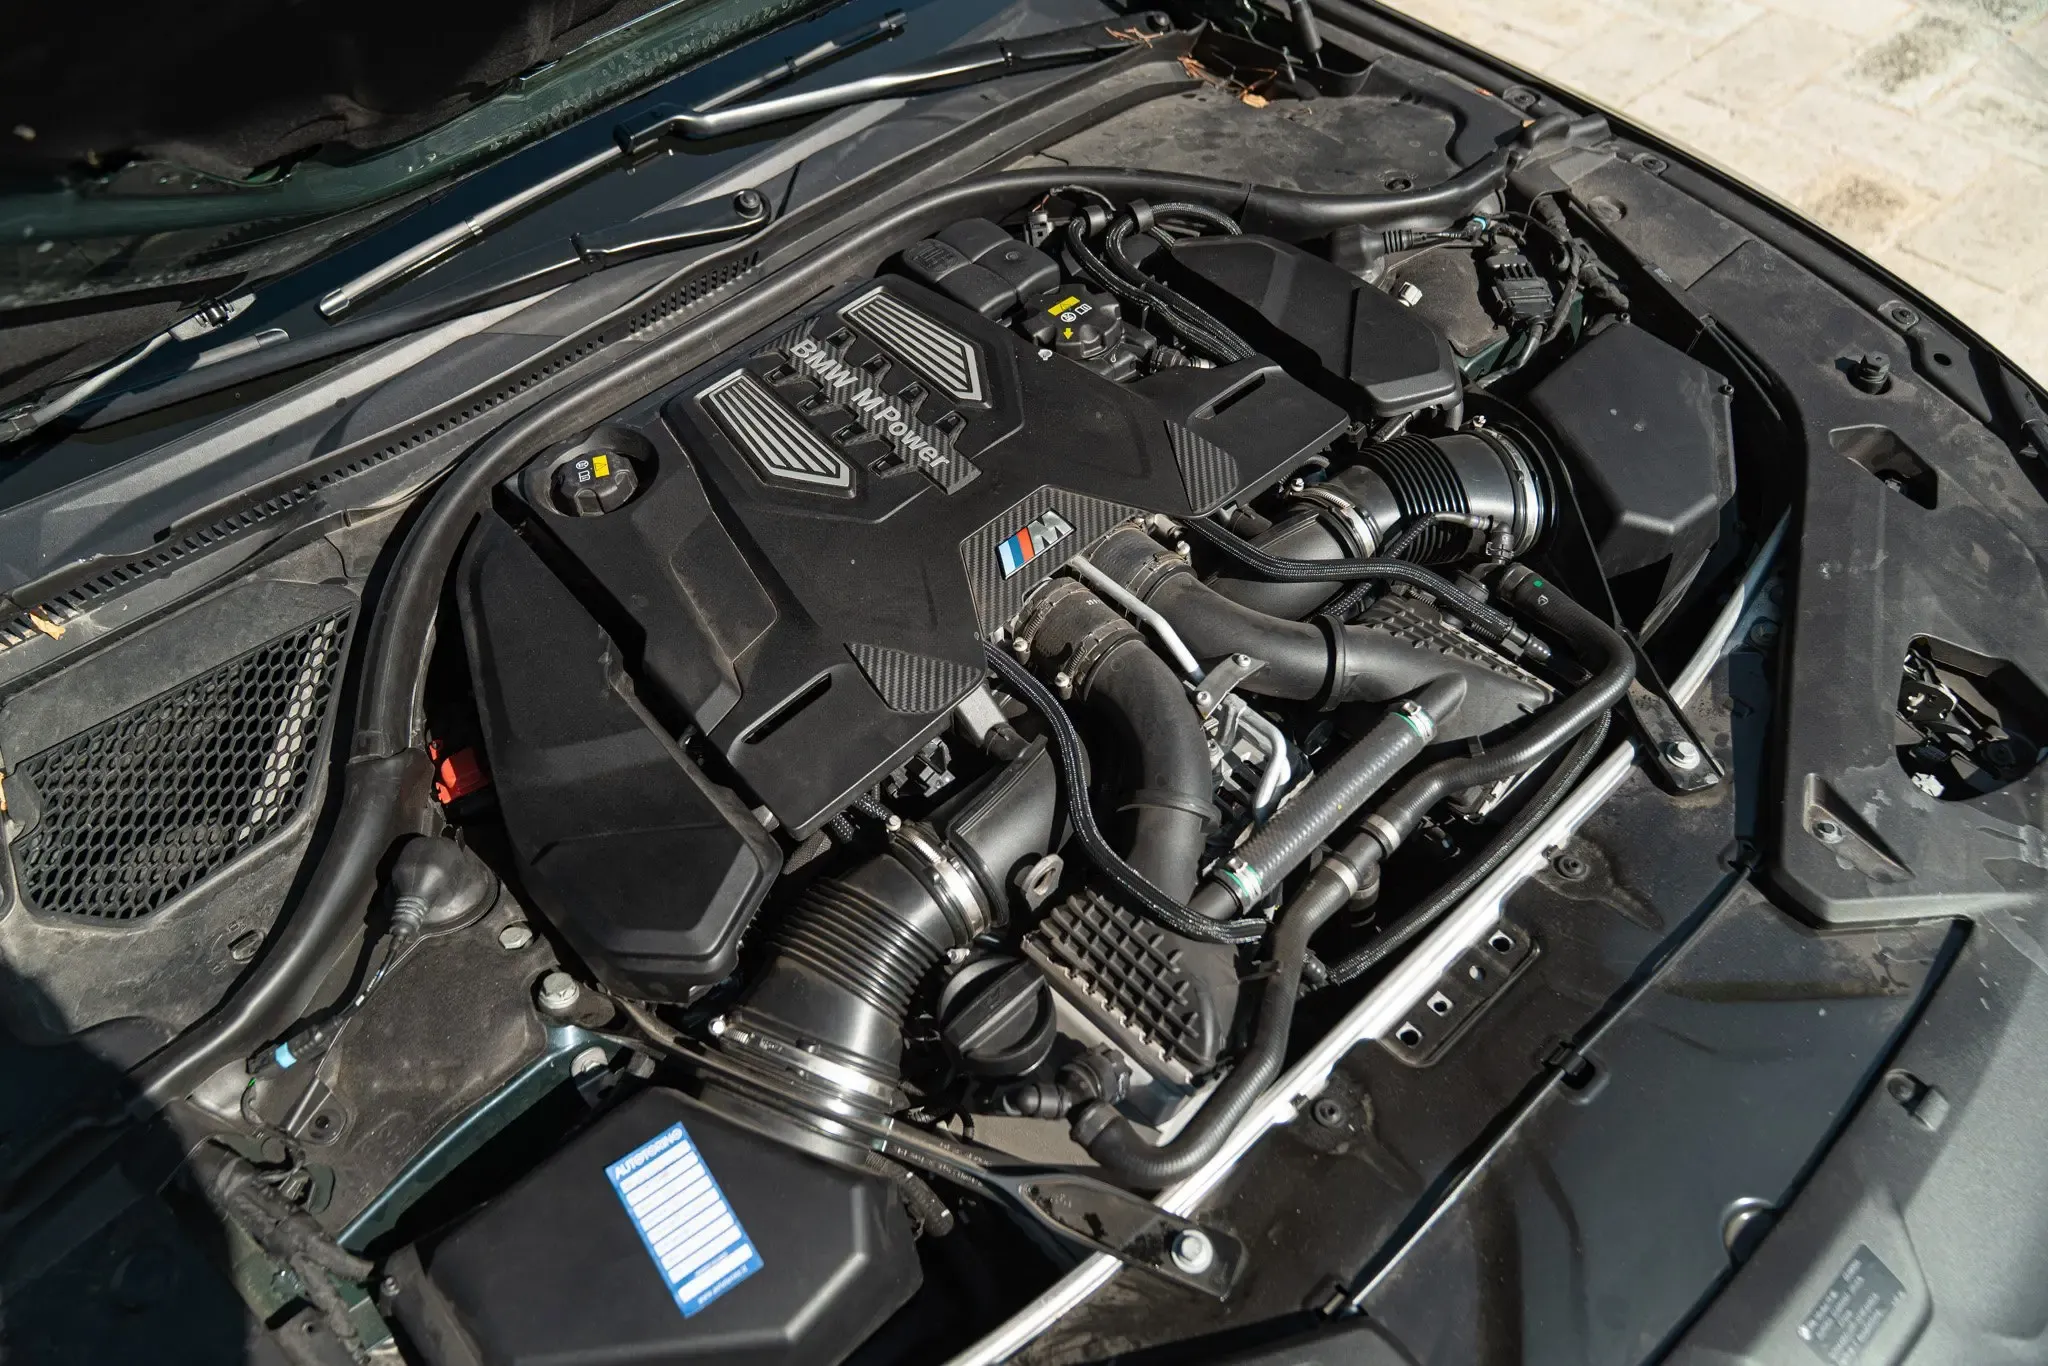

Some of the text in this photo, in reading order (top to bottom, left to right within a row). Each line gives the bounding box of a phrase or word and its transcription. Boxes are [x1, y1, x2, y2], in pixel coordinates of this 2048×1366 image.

[790, 338, 950, 469] BMW M Power
[614, 1127, 683, 1181] AUTOTORINO
